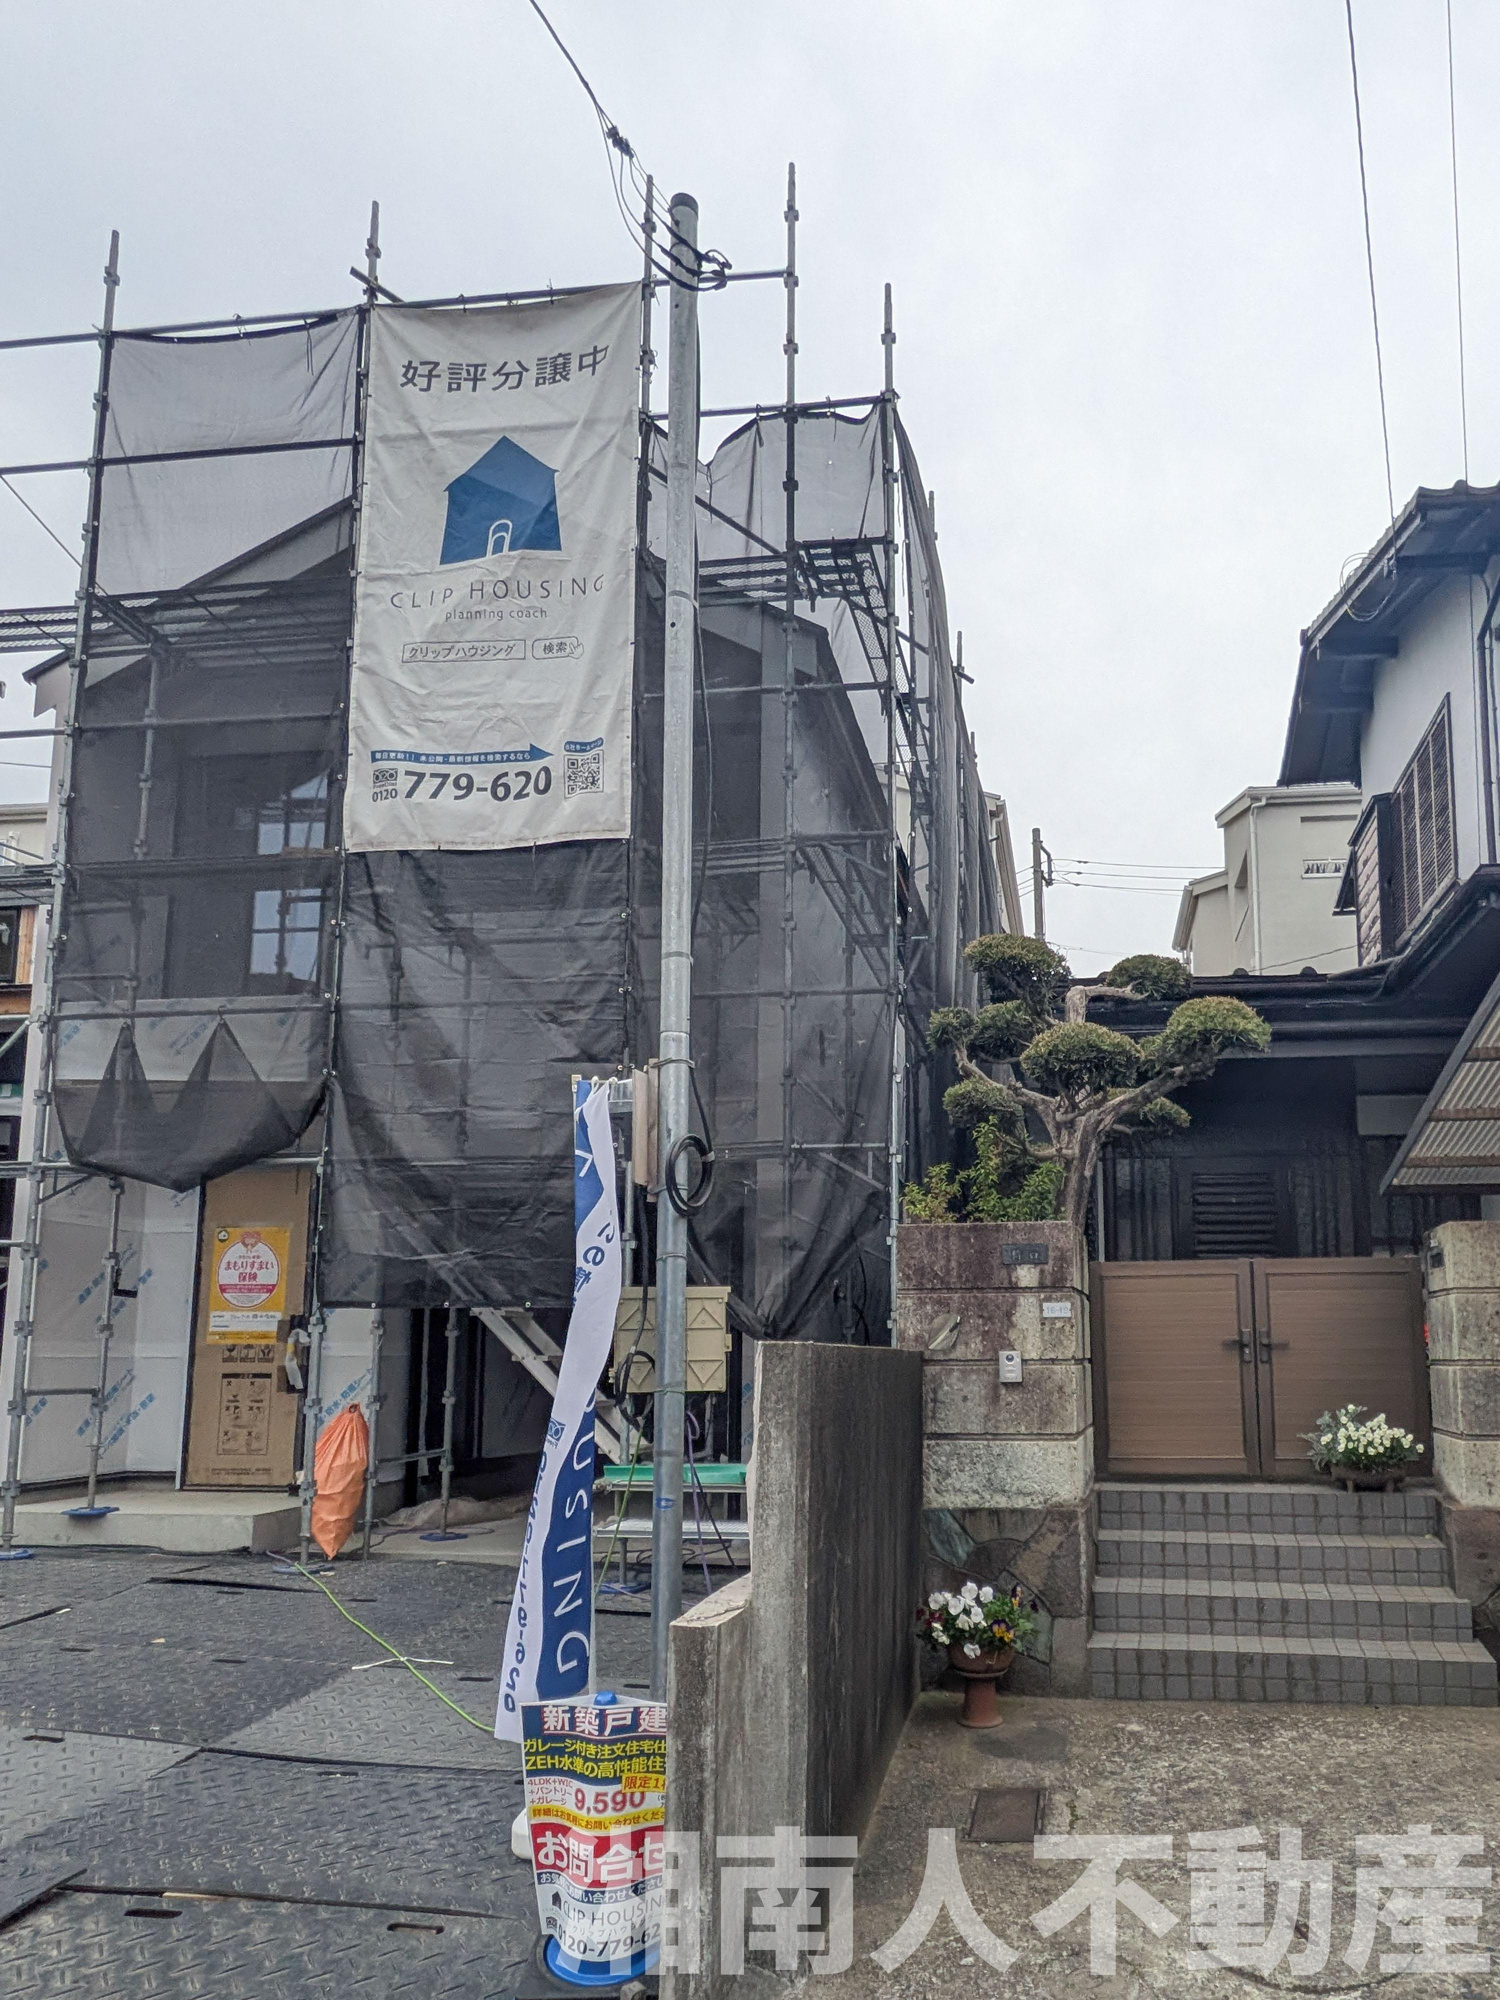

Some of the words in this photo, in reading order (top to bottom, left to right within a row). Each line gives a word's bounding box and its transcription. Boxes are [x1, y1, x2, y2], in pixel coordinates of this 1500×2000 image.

[400, 345, 609, 393] 好評分譲中
[391, 588, 453, 608] CLIP
[470, 574, 604, 600] HOUSING
[445, 609, 503, 621] planning
[509, 608, 548, 619] coach
[408, 643, 516, 659] クリップハウジング
[543, 641, 567, 655] 検索
[372, 788, 398, 802] 0120
[404, 765, 552, 802] 779-620
[543, 1705, 667, 1736] 新築戸建
[525, 1754, 667, 1779] ZEH水準の高性能住
[528, 1777, 573, 1788] 4LDK+WIC
[624, 1776, 665, 1789] 限定1
[574, 1788, 646, 1815] 9,590
[563, 1900, 586, 1921] CLIP
